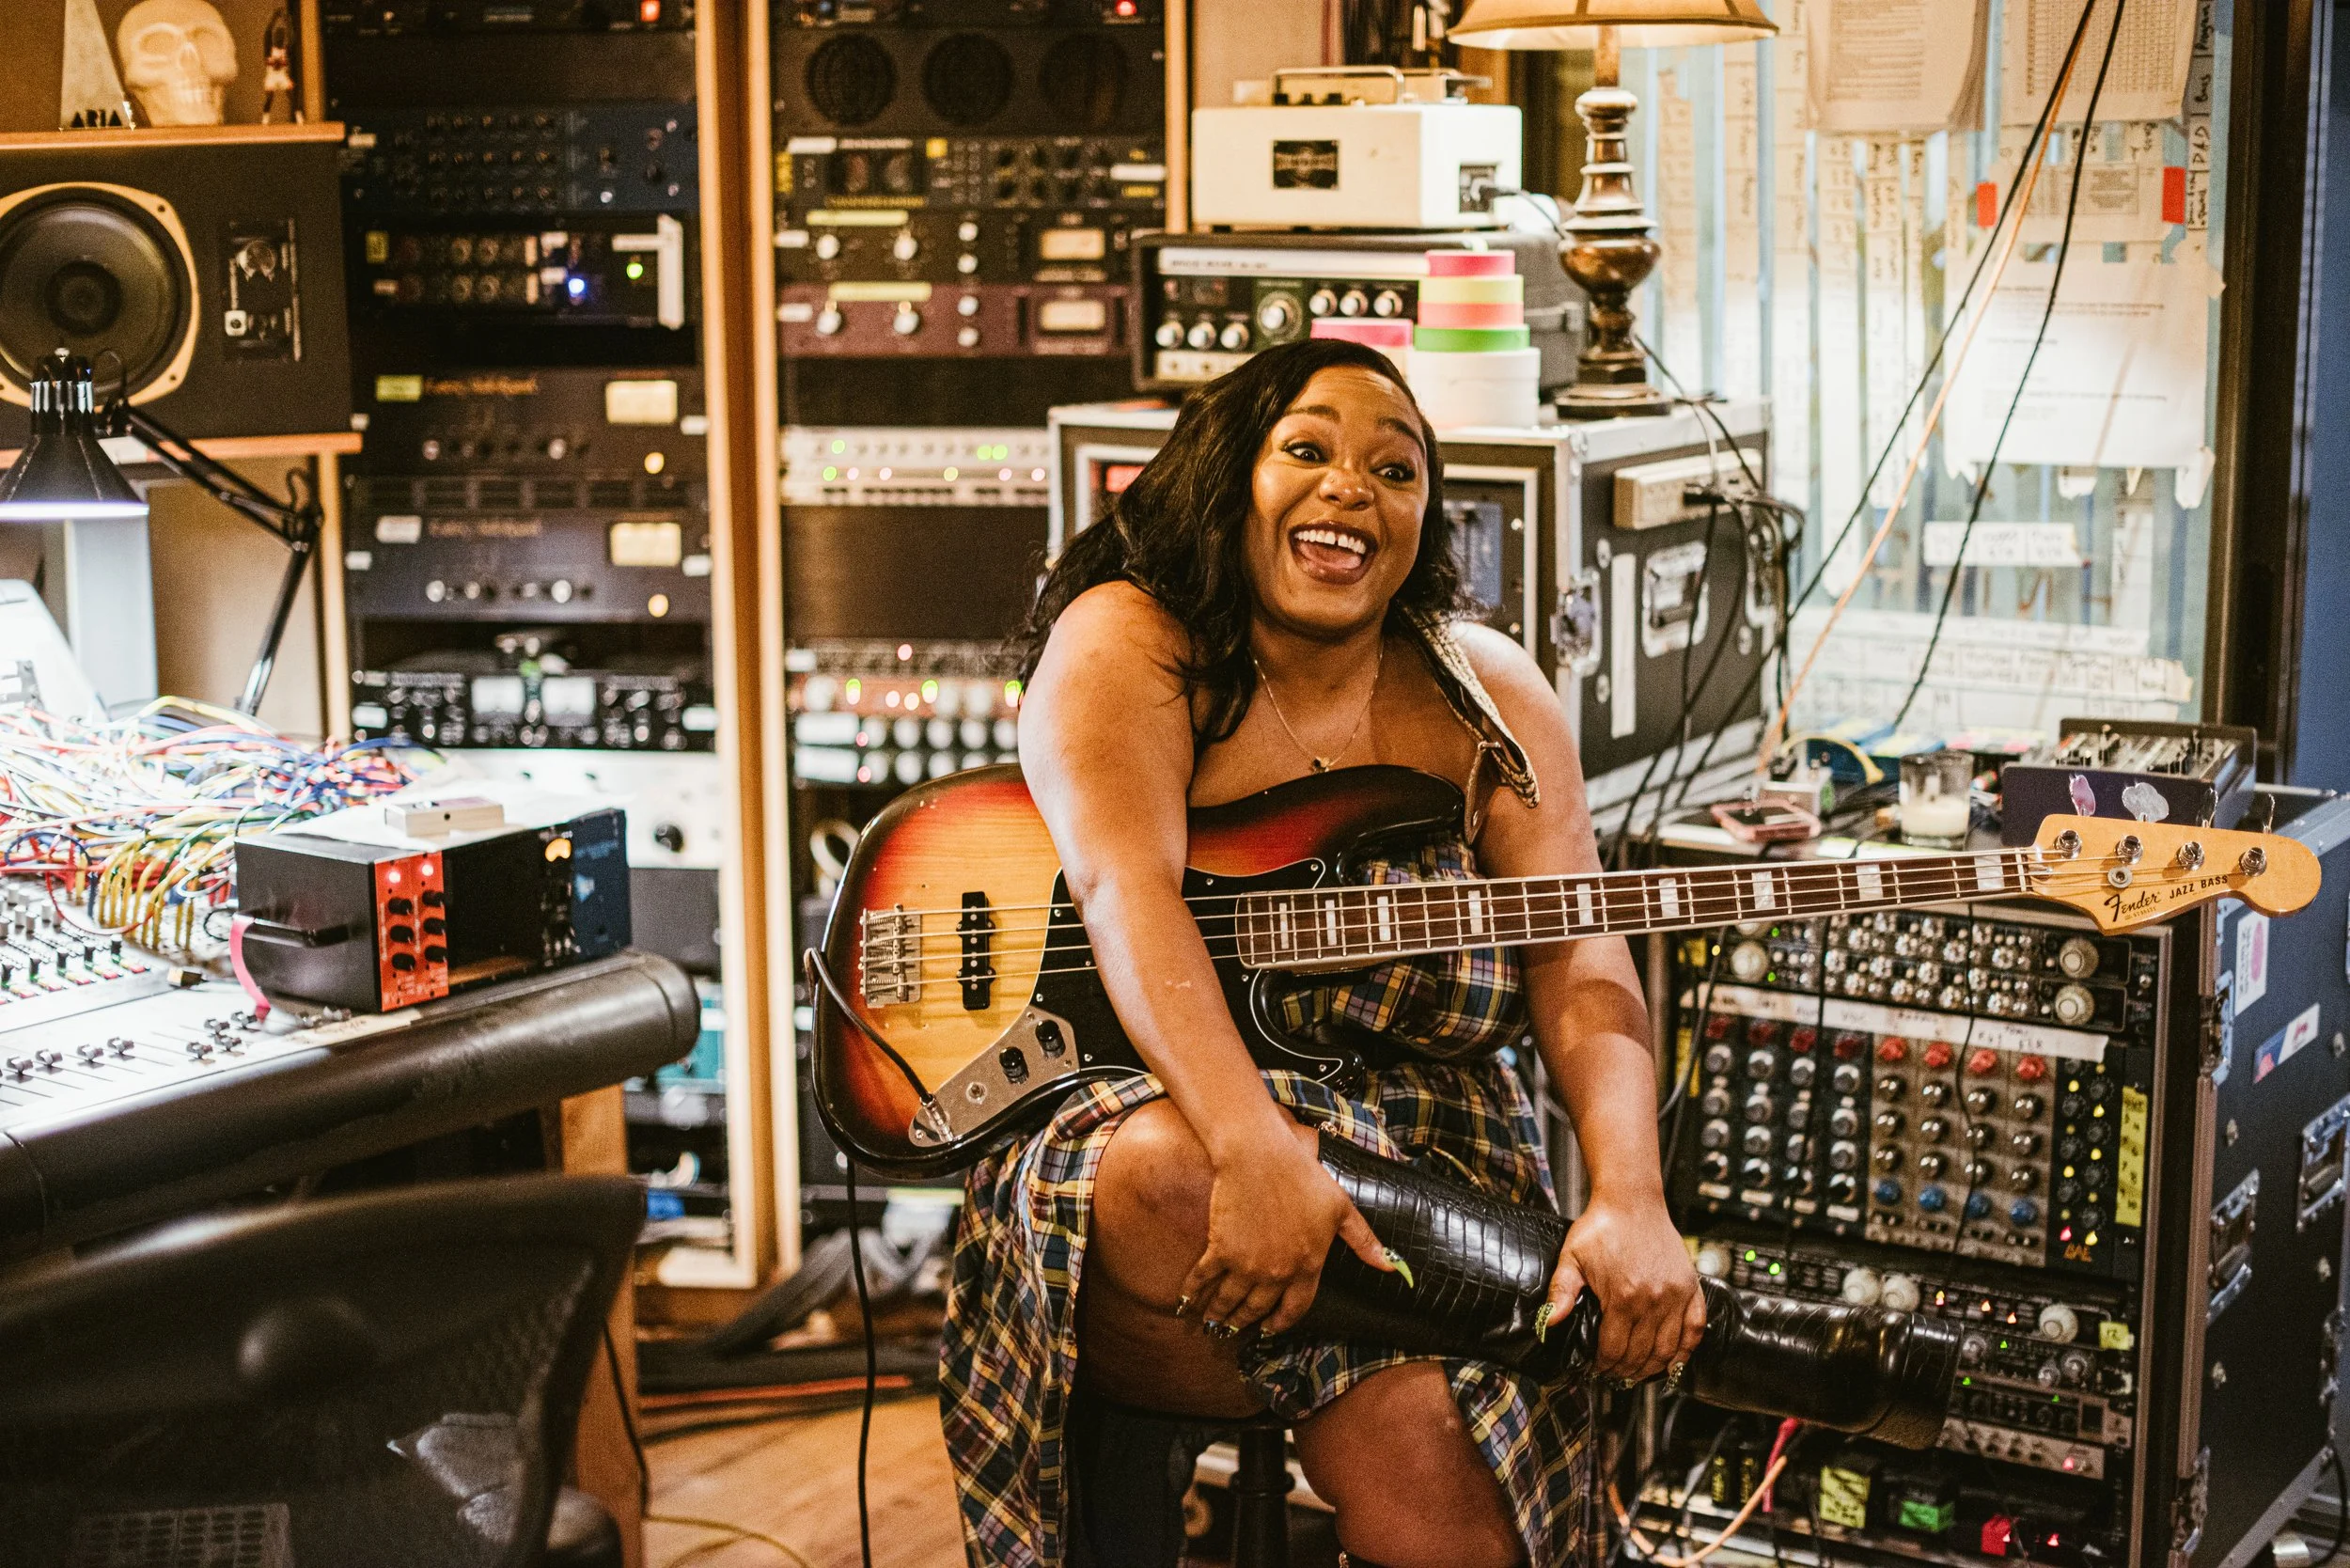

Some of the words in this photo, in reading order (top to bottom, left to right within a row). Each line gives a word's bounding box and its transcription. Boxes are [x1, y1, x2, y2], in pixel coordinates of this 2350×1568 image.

[70, 109, 123, 128] ARIA
[2170, 883, 2194, 899] JAZZ
[2201, 874, 2228, 889] BASS
[2104, 891, 2161, 922] Fender
